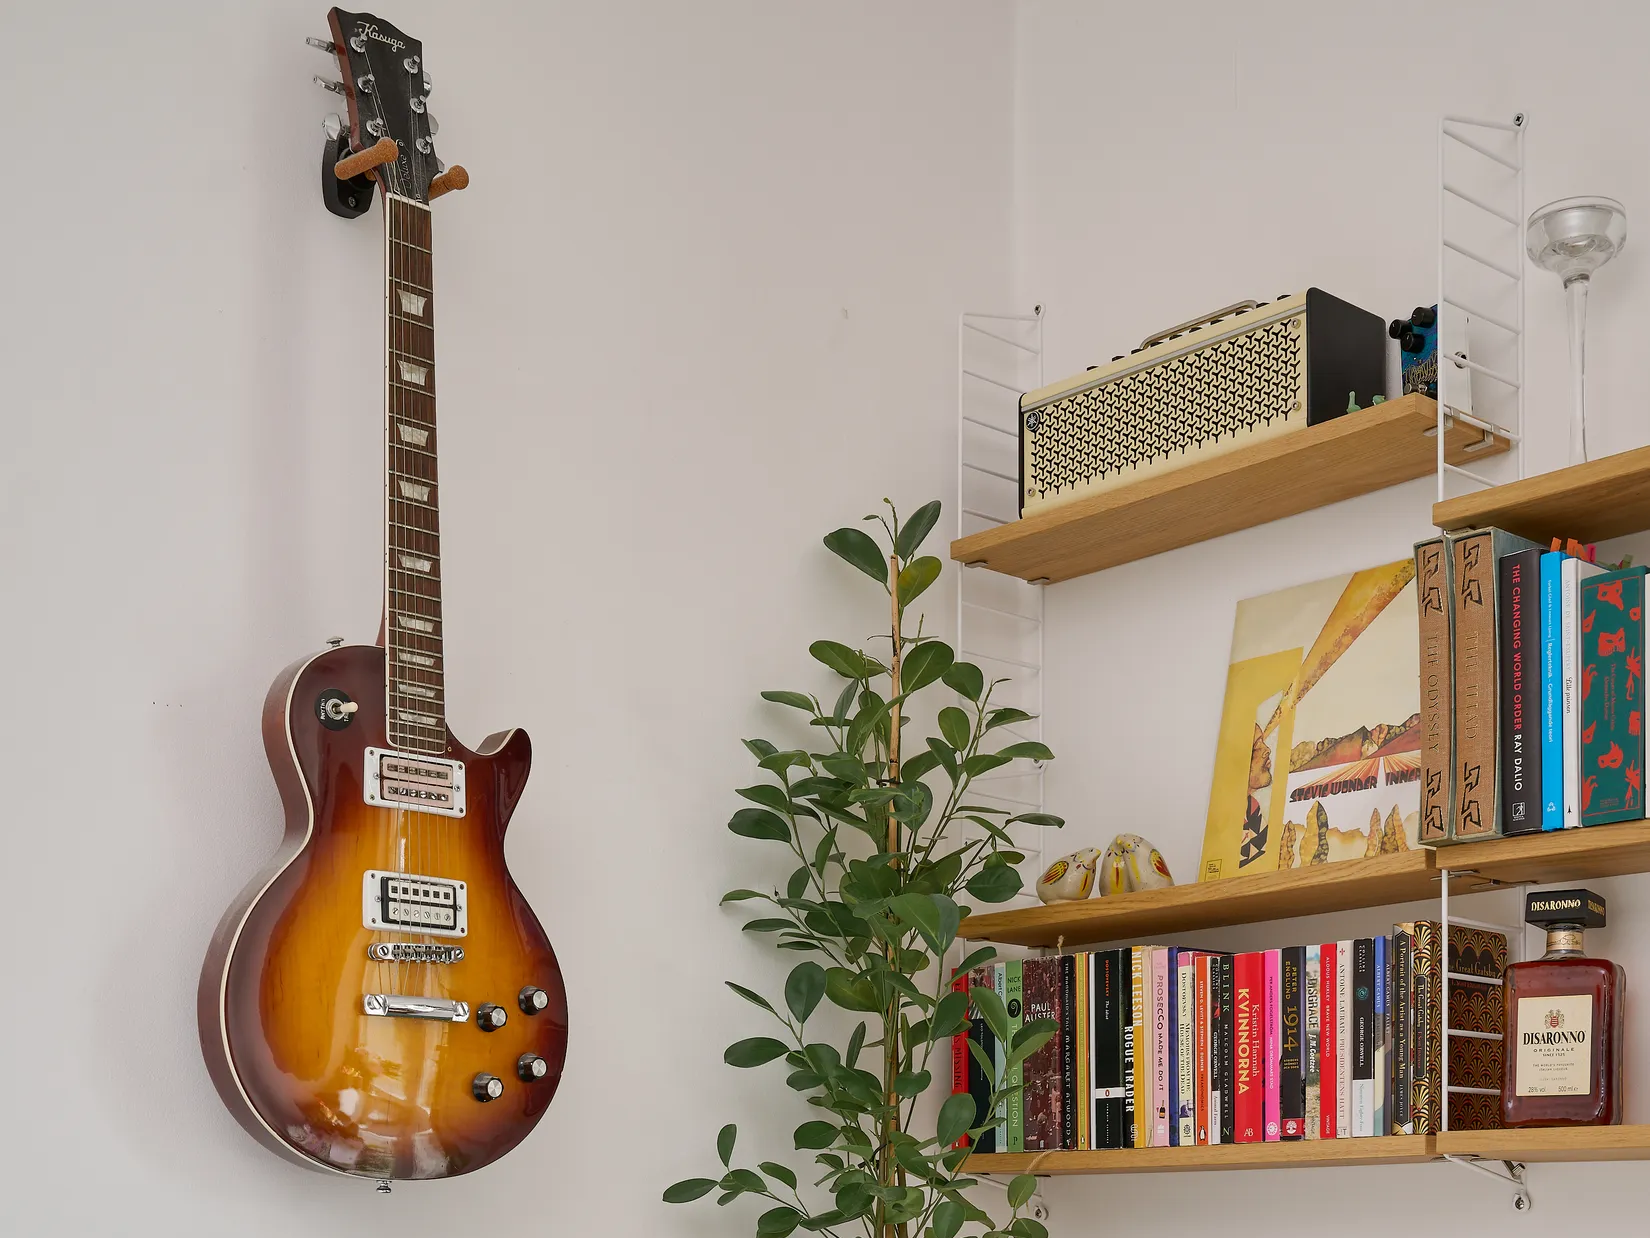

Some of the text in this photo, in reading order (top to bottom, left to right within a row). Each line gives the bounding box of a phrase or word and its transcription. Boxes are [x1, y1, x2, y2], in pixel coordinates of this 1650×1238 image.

[356, 21, 406, 52] Kasuga
[1512, 564, 1522, 730] THE CHANGING WORLD ORDER
[1427, 631, 1440, 752] THE ODYSSEY
[1465, 631, 1479, 739] THE ILIAD
[1513, 734, 1523, 791] RAY DALIO
[1289, 785, 1328, 803] STEVIE
[1330, 775, 1378, 795] WONDER
[1531, 899, 1581, 911] DISARONNO
[1132, 952, 1142, 1026] NICK LEESON
[1156, 975, 1164, 1030] PROSECCO
[1222, 964, 1230, 1012] BLINK
[1307, 977, 1318, 1028] DISGRACE
[1400, 978, 1406, 986] of
[1024, 1011, 1056, 1023] AUSTER
[1030, 1002, 1050, 1012] PAUL
[1283, 1006, 1299, 1052] 1914
[1238, 988, 1250, 1095] KVINNORNA
[1252, 1004, 1260, 1077] Kristin Hannah
[1523, 1030, 1585, 1045] DISARONNO
[954, 1048, 962, 1088] MISSING
[1124, 1025, 1135, 1112] ROGUE TRADER
[1158, 1056, 1164, 1067] ME
[1158, 1070, 1164, 1081] DO
